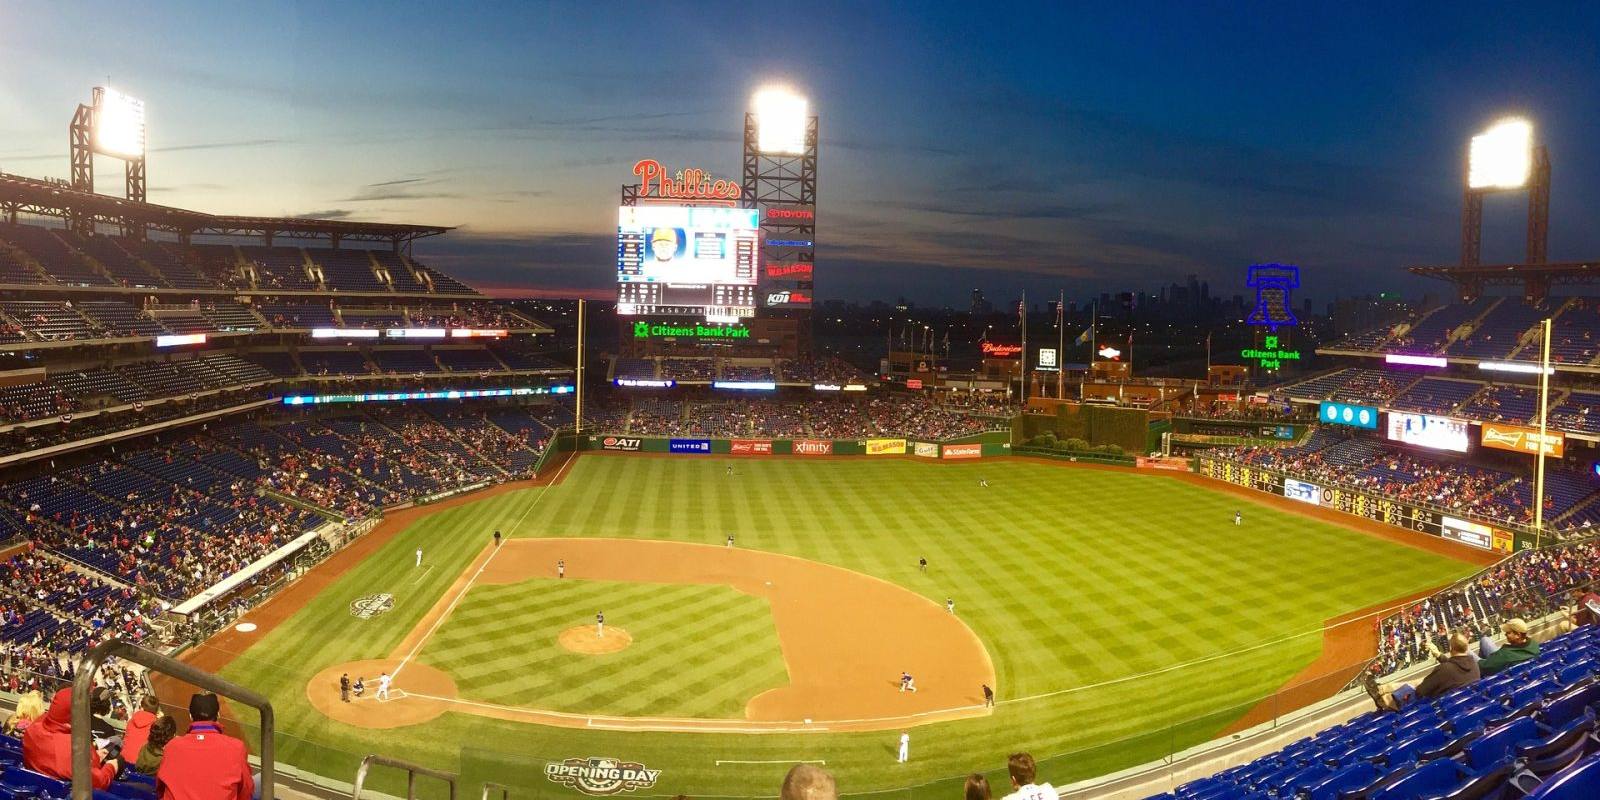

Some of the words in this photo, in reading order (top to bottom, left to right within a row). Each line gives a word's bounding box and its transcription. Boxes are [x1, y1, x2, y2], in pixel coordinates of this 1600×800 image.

[633, 159, 741, 199] Phillies
[778, 210, 813, 218] TOYOTA
[651, 325, 694, 336] Citizens
[696, 327, 724, 337] Bank
[725, 326, 750, 338] Park
[982, 343, 1022, 353] Budweiser
[1241, 349, 1277, 358] Citizens
[1278, 350, 1300, 359] Bank
[1260, 359, 1280, 368] Park
[616, 438, 640, 447] ATI
[795, 441, 830, 454] xfinity
[1521, 540, 1533, 549] 330
[546, 764, 620, 780] OPENING
[623, 769, 662, 783] DAY
